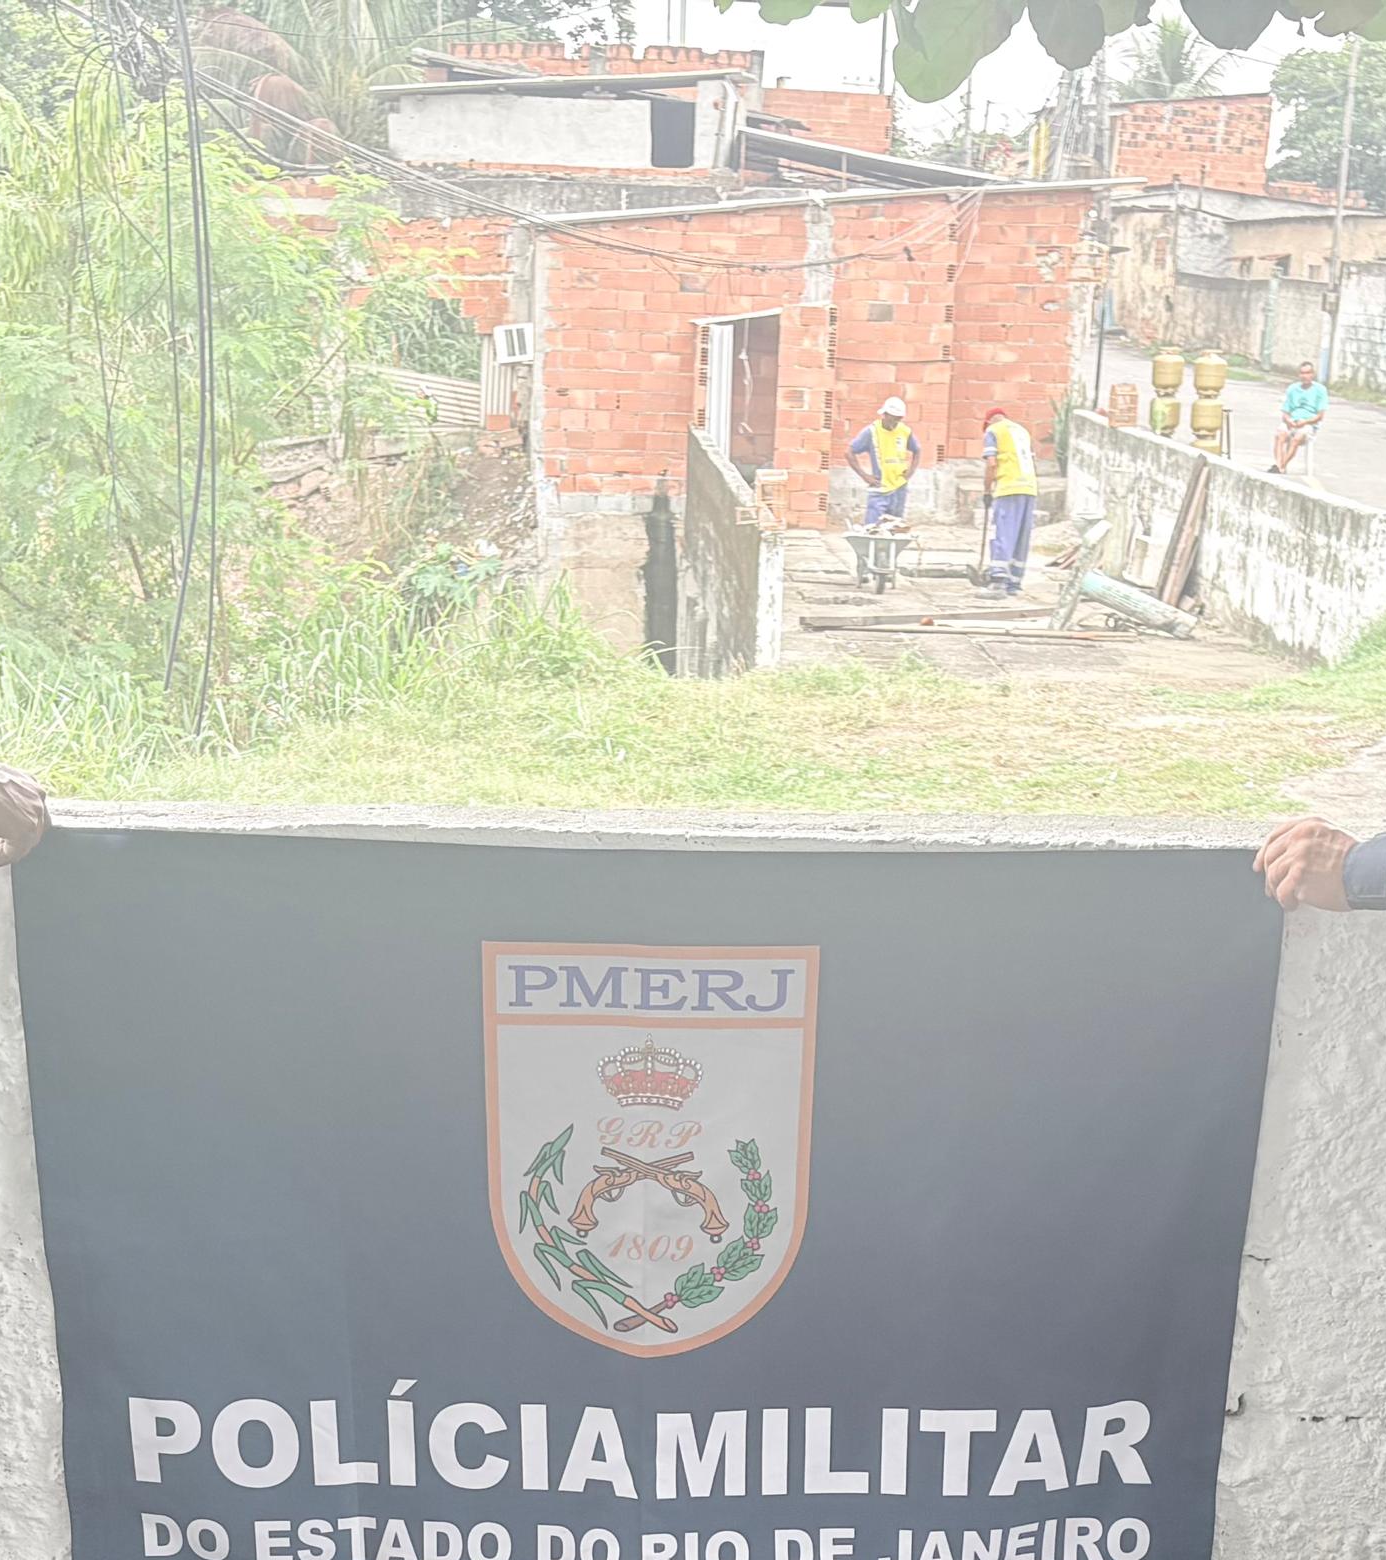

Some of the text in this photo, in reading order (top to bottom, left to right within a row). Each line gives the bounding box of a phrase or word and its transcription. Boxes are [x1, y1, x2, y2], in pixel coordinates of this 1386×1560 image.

[508, 964, 795, 1012] PMERJ
[606, 1232, 694, 1262] 1809
[127, 1378, 1153, 1500] POLÍCIA MILITAR
[139, 1511, 231, 1560] DO
